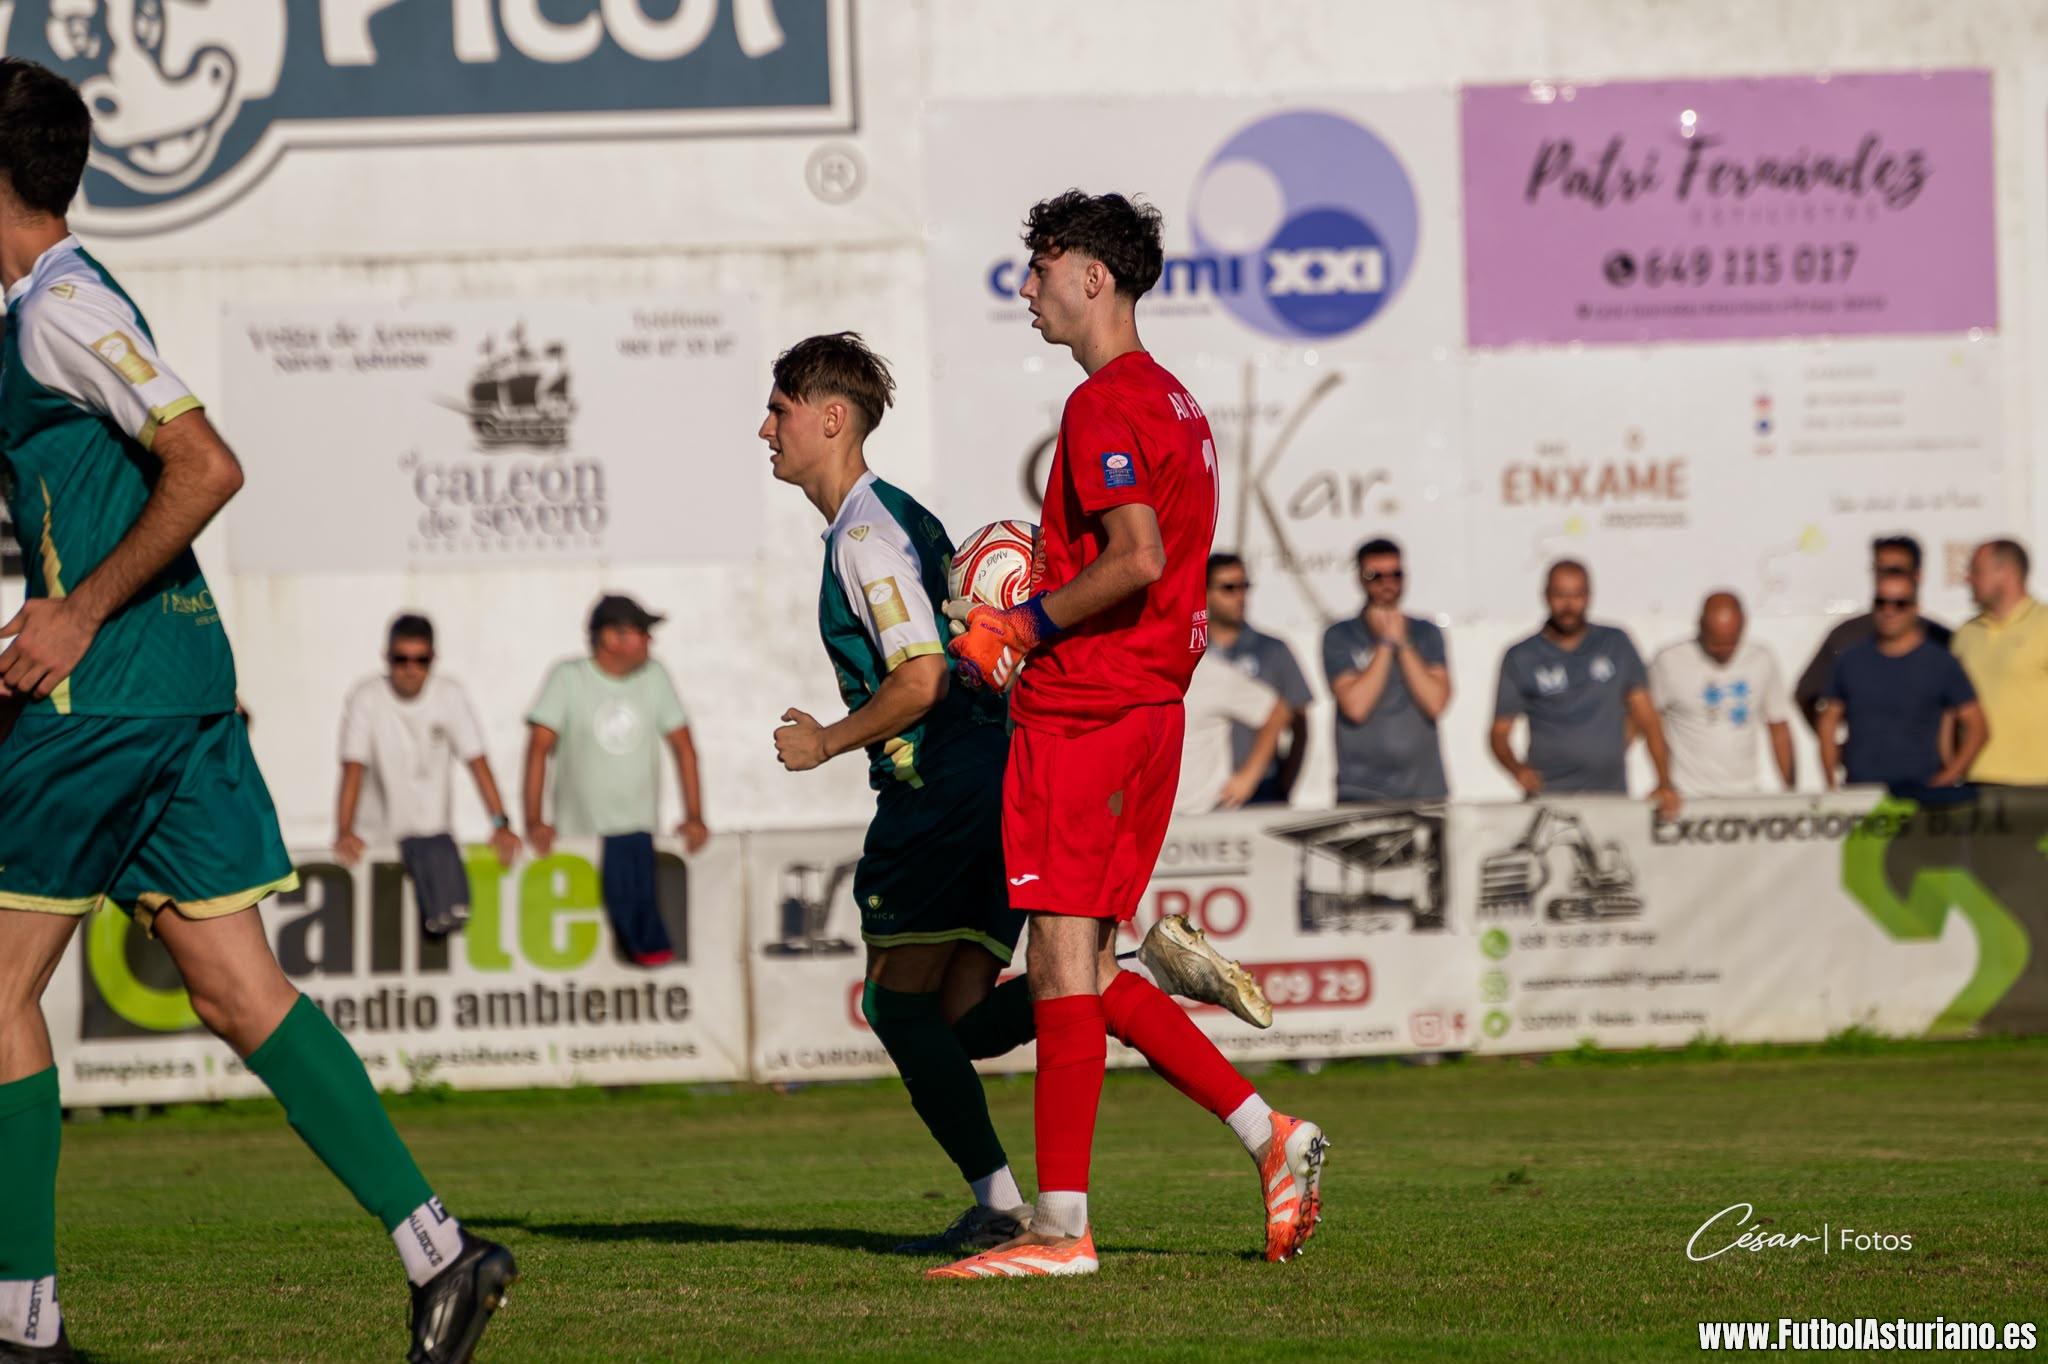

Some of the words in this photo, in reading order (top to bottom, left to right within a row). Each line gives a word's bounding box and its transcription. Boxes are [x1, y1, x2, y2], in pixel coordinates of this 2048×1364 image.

[1525, 134, 1662, 208] Patri
[1266, 250, 1384, 297] XXI
[1643, 246, 1712, 288] 649
[1722, 245, 1783, 286] 115
[1792, 241, 1859, 284] 017
[1501, 455, 1690, 507] ENXAME
[455, 978, 692, 1028] ambiente
[1320, 966, 1365, 1000] 29
[570, 1041, 698, 1061] servicios
